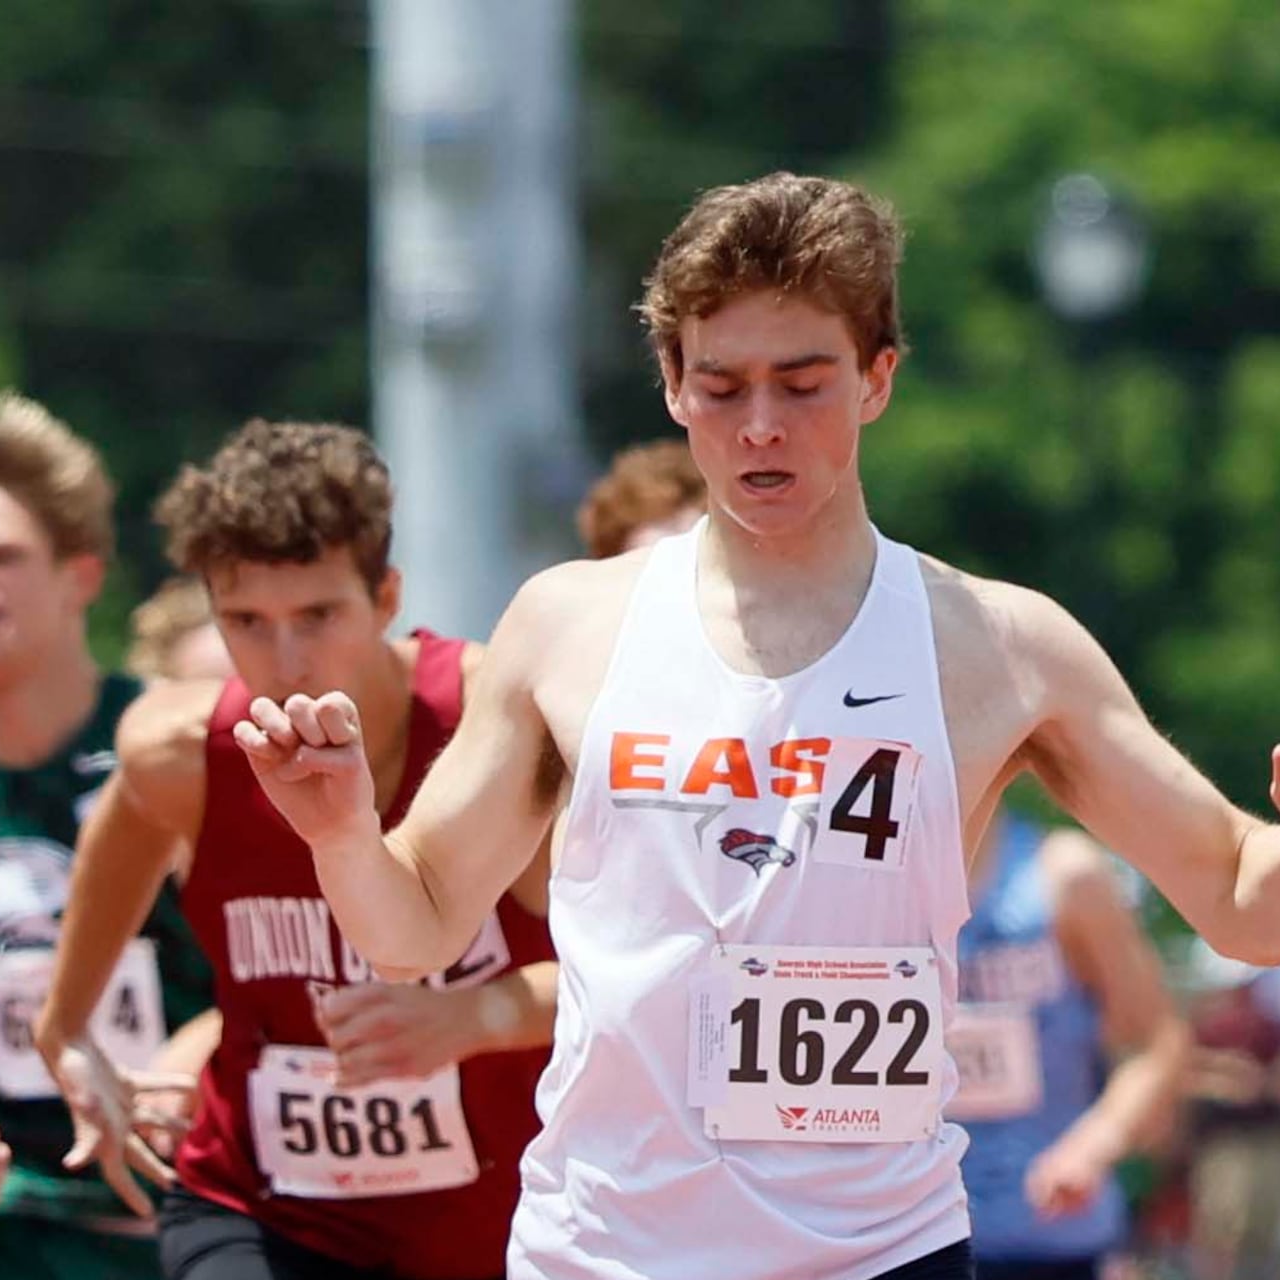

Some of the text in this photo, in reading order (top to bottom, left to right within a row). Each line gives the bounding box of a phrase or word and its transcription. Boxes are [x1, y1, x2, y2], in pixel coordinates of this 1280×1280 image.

[609, 732, 911, 799] EAS
[829, 748, 901, 861] 4
[222, 897, 336, 983] UNION
[728, 998, 930, 1086] 1622
[279, 1091, 452, 1158] 5681
[814, 1108, 880, 1124] ATLANTA
